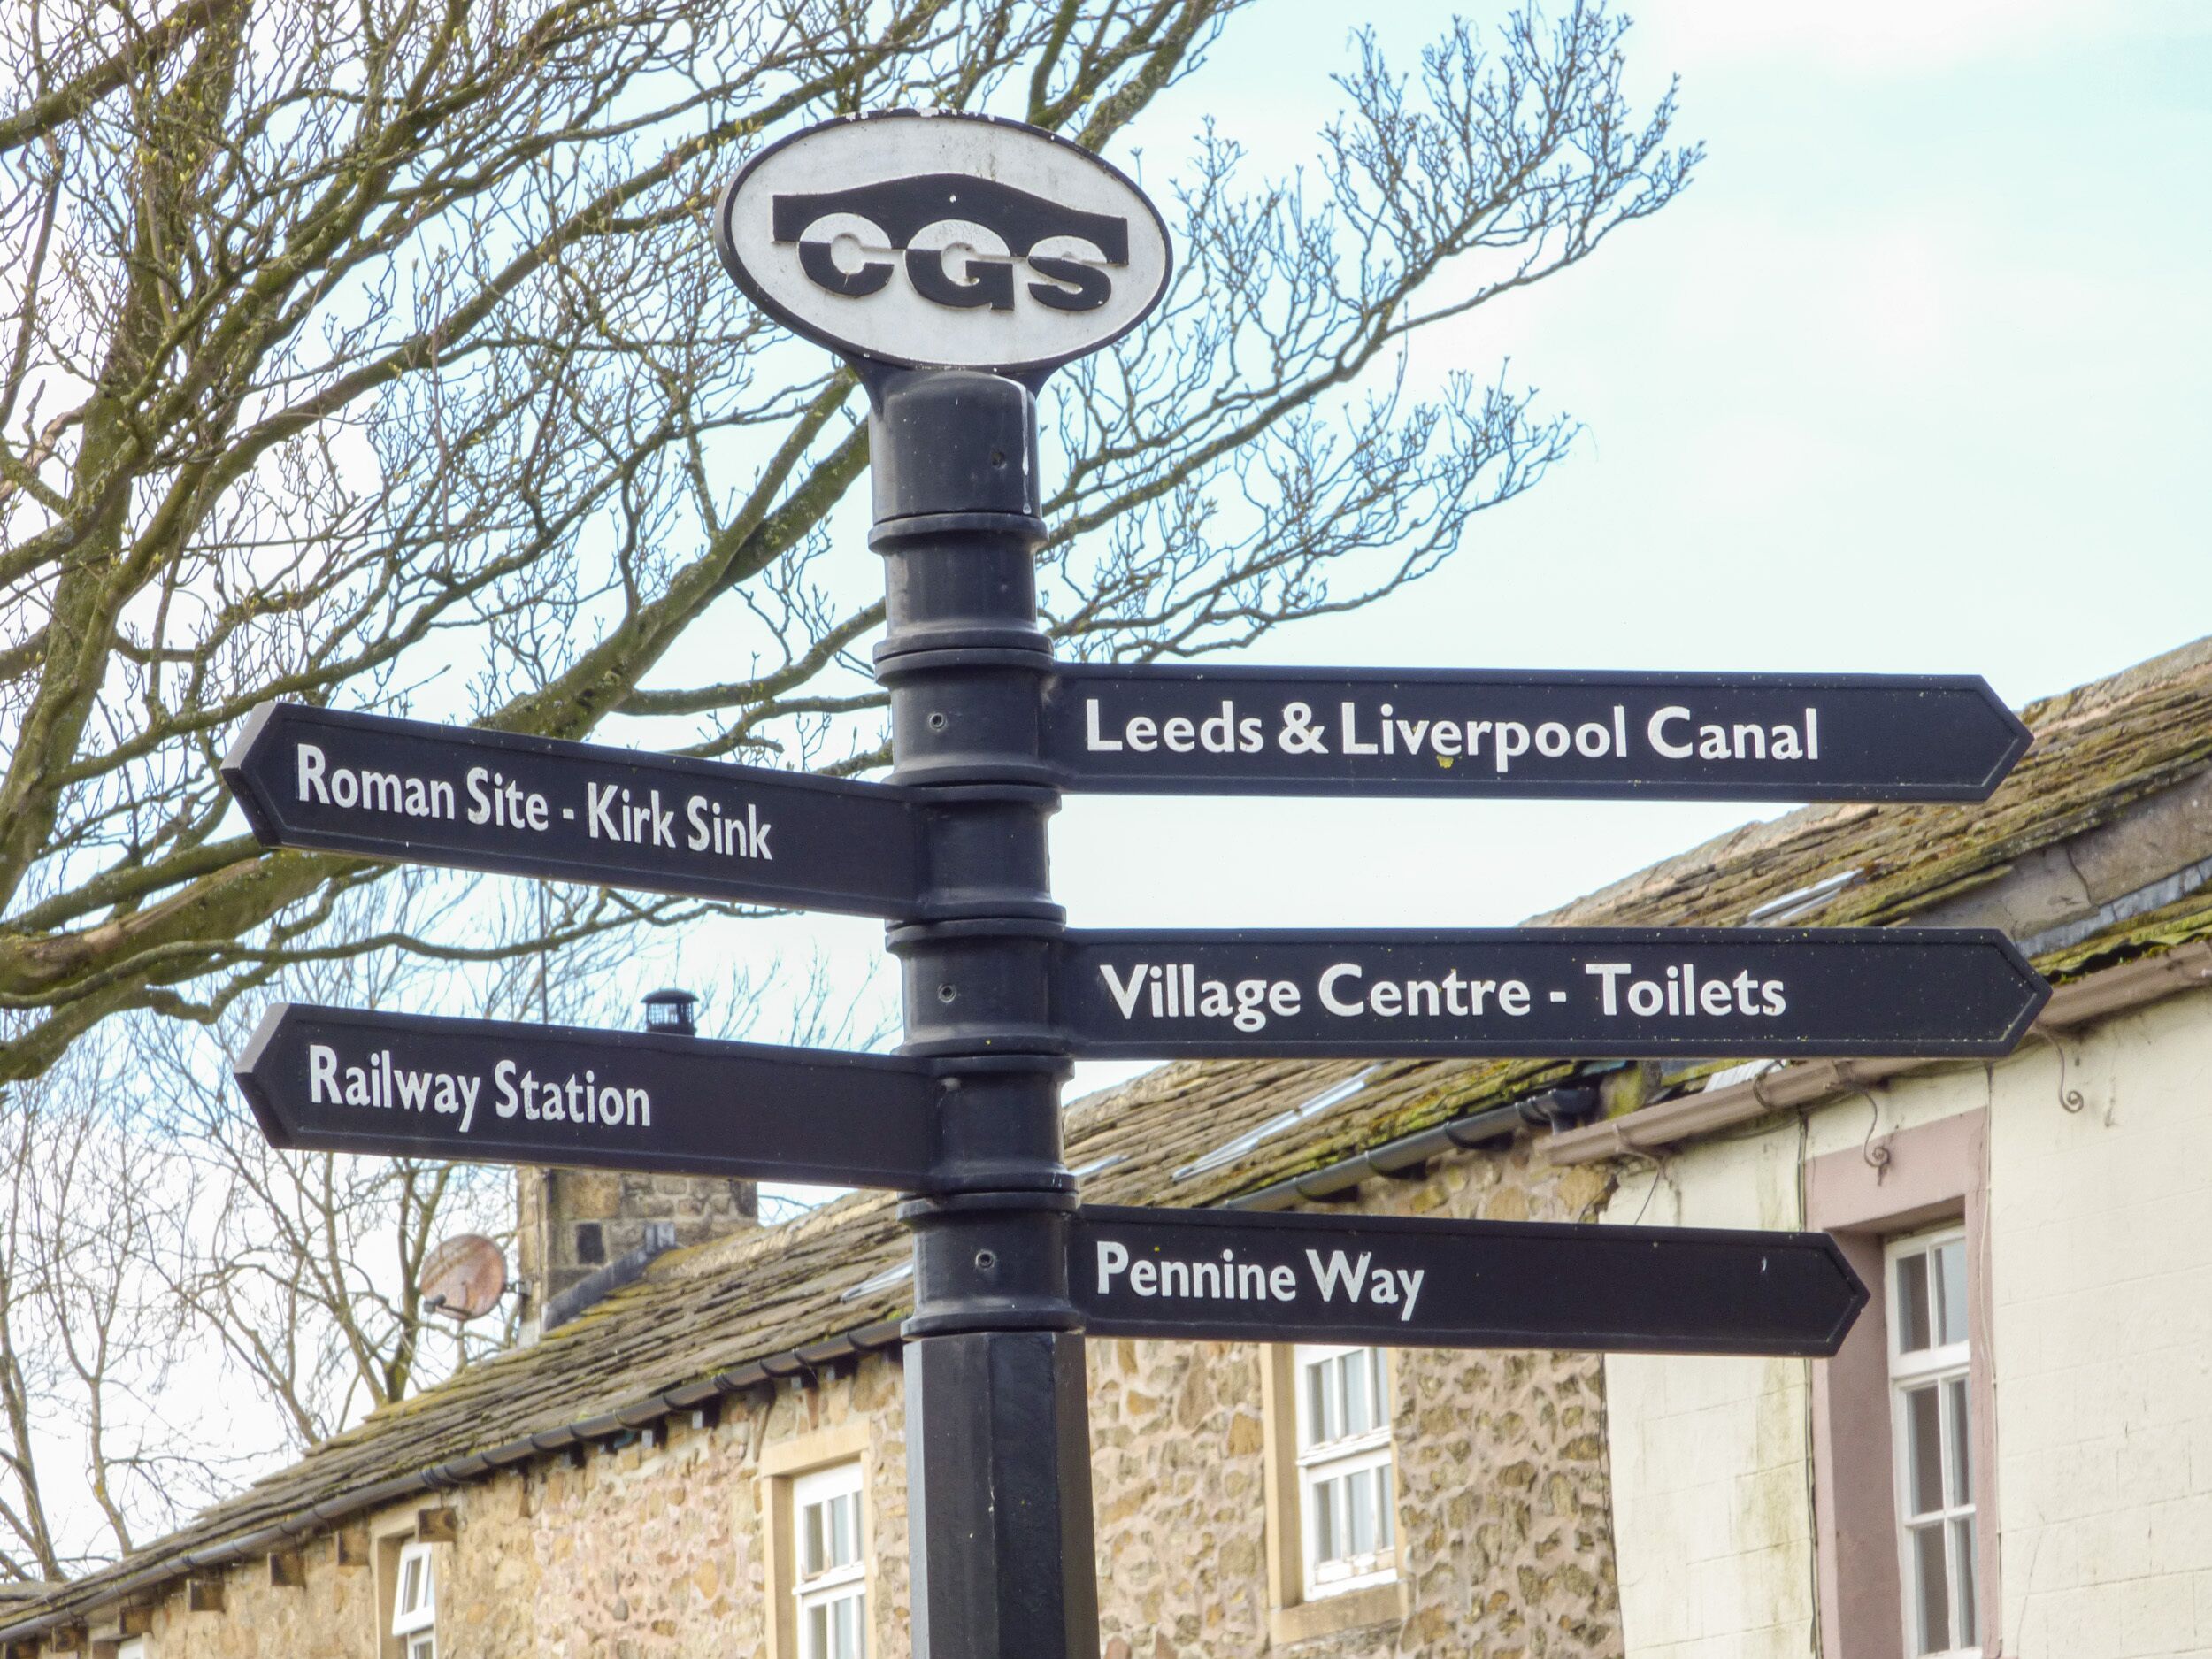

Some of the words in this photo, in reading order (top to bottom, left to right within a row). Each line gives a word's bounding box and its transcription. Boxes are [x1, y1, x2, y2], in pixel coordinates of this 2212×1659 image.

[797, 212, 1112, 311] CGS
[1086, 698, 1264, 754] Leeds
[1278, 701, 1329, 755] &
[1340, 701, 1627, 773] Liverpool
[1647, 705, 1818, 760] Canal
[297, 742, 452, 820] Roman
[465, 766, 549, 835] Site
[562, 808, 575, 820] -
[588, 781, 676, 849] Kirk
[687, 795, 773, 861] Sink
[1099, 963, 1301, 1033] Village
[1317, 962, 1531, 1018] Centre
[1549, 990, 1567, 1002] -
[1585, 963, 1786, 1017] Toilets
[309, 1044, 481, 1133] Railway
[494, 1059, 651, 1128] Station
[1096, 1240, 1296, 1302] Pennine
[1305, 1248, 1425, 1322] Way
